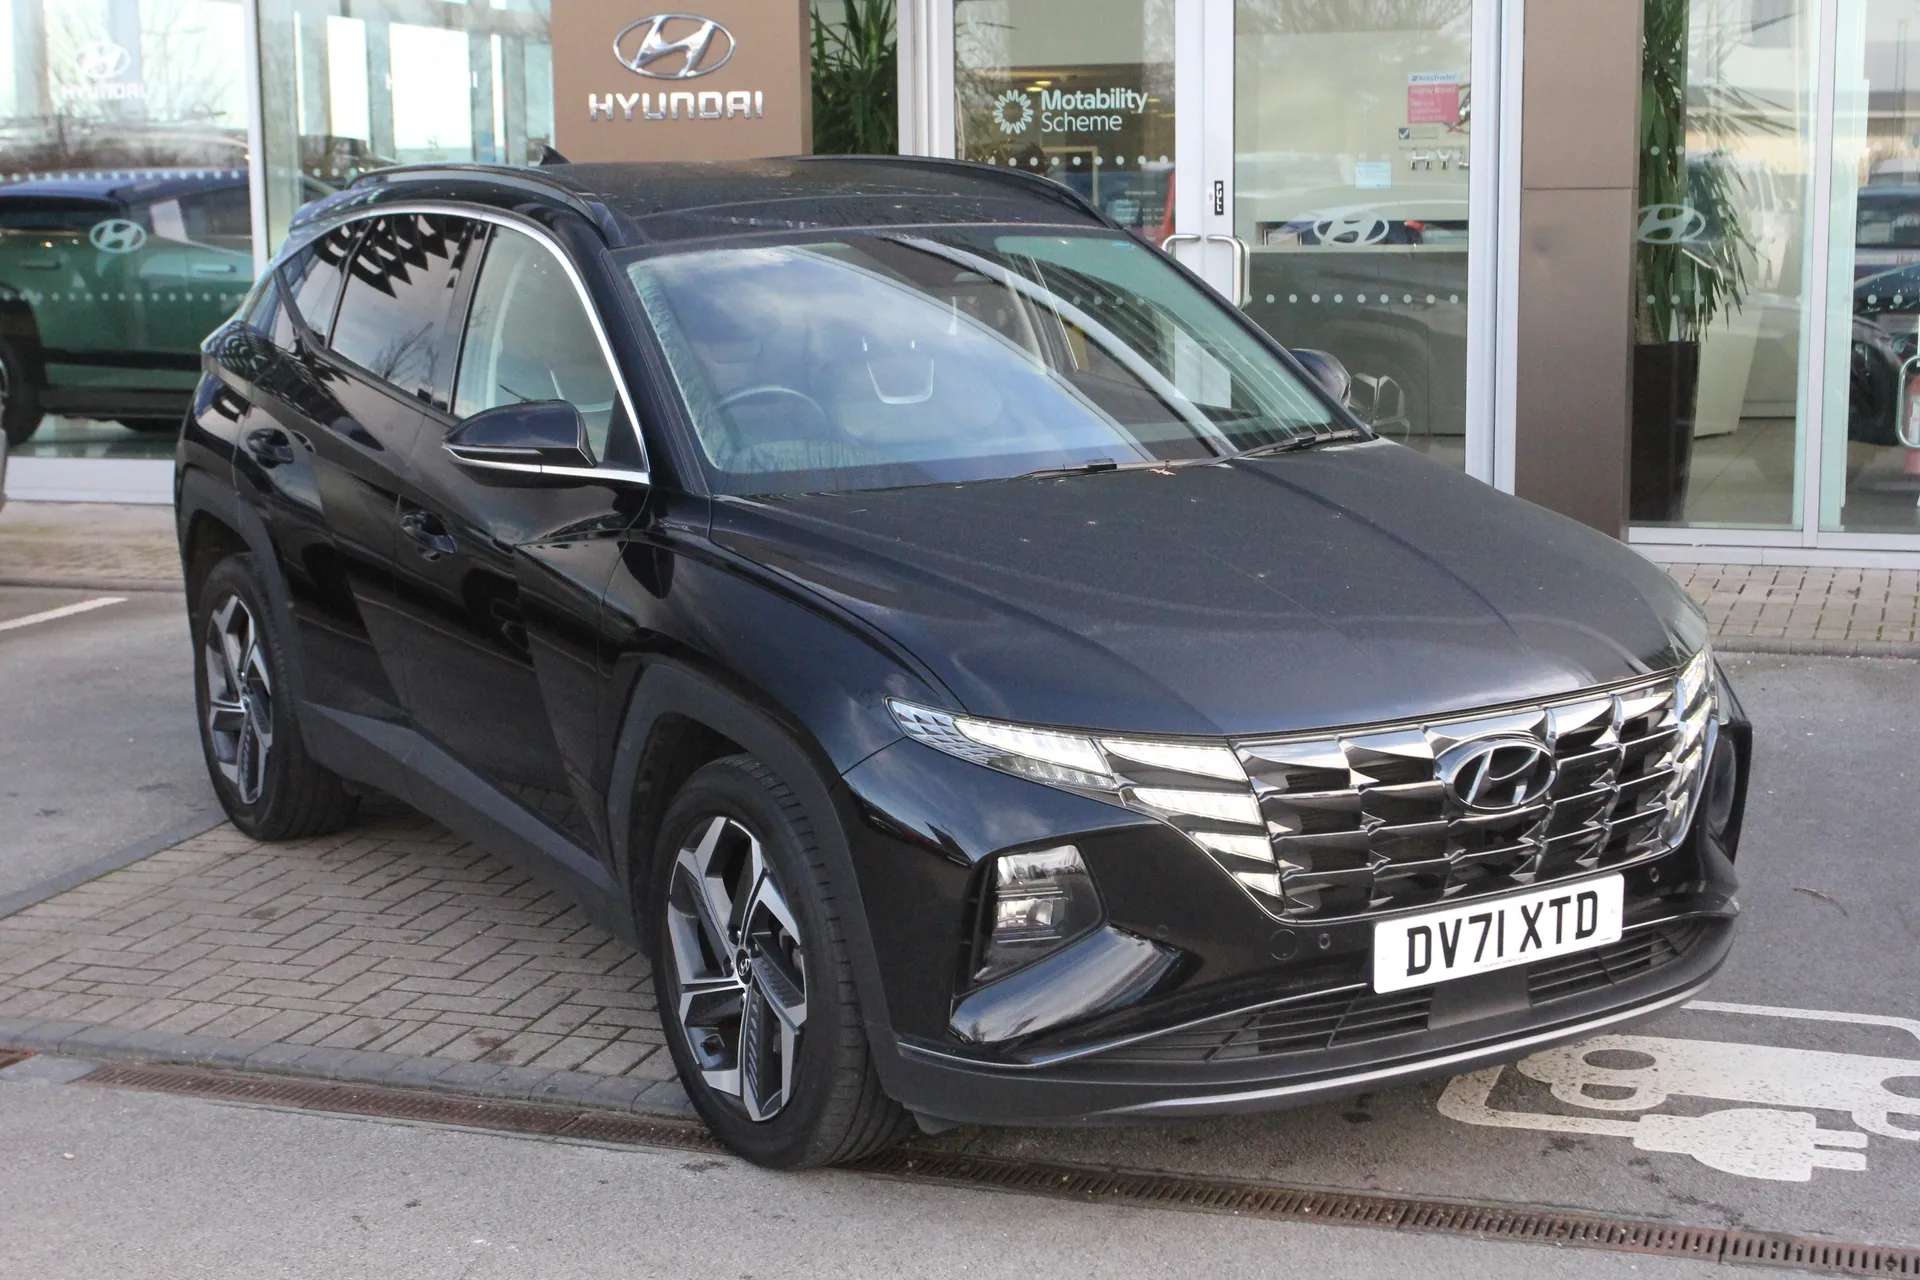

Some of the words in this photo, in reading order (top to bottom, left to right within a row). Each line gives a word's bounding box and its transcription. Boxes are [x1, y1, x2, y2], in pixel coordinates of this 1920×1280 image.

[588, 90, 763, 120] HYUNDAI
[1041, 88, 1149, 114] Motability
[1041, 113, 1122, 132] Scheme
[1406, 909, 1505, 977] DV71
[1519, 890, 1598, 953] XTD
